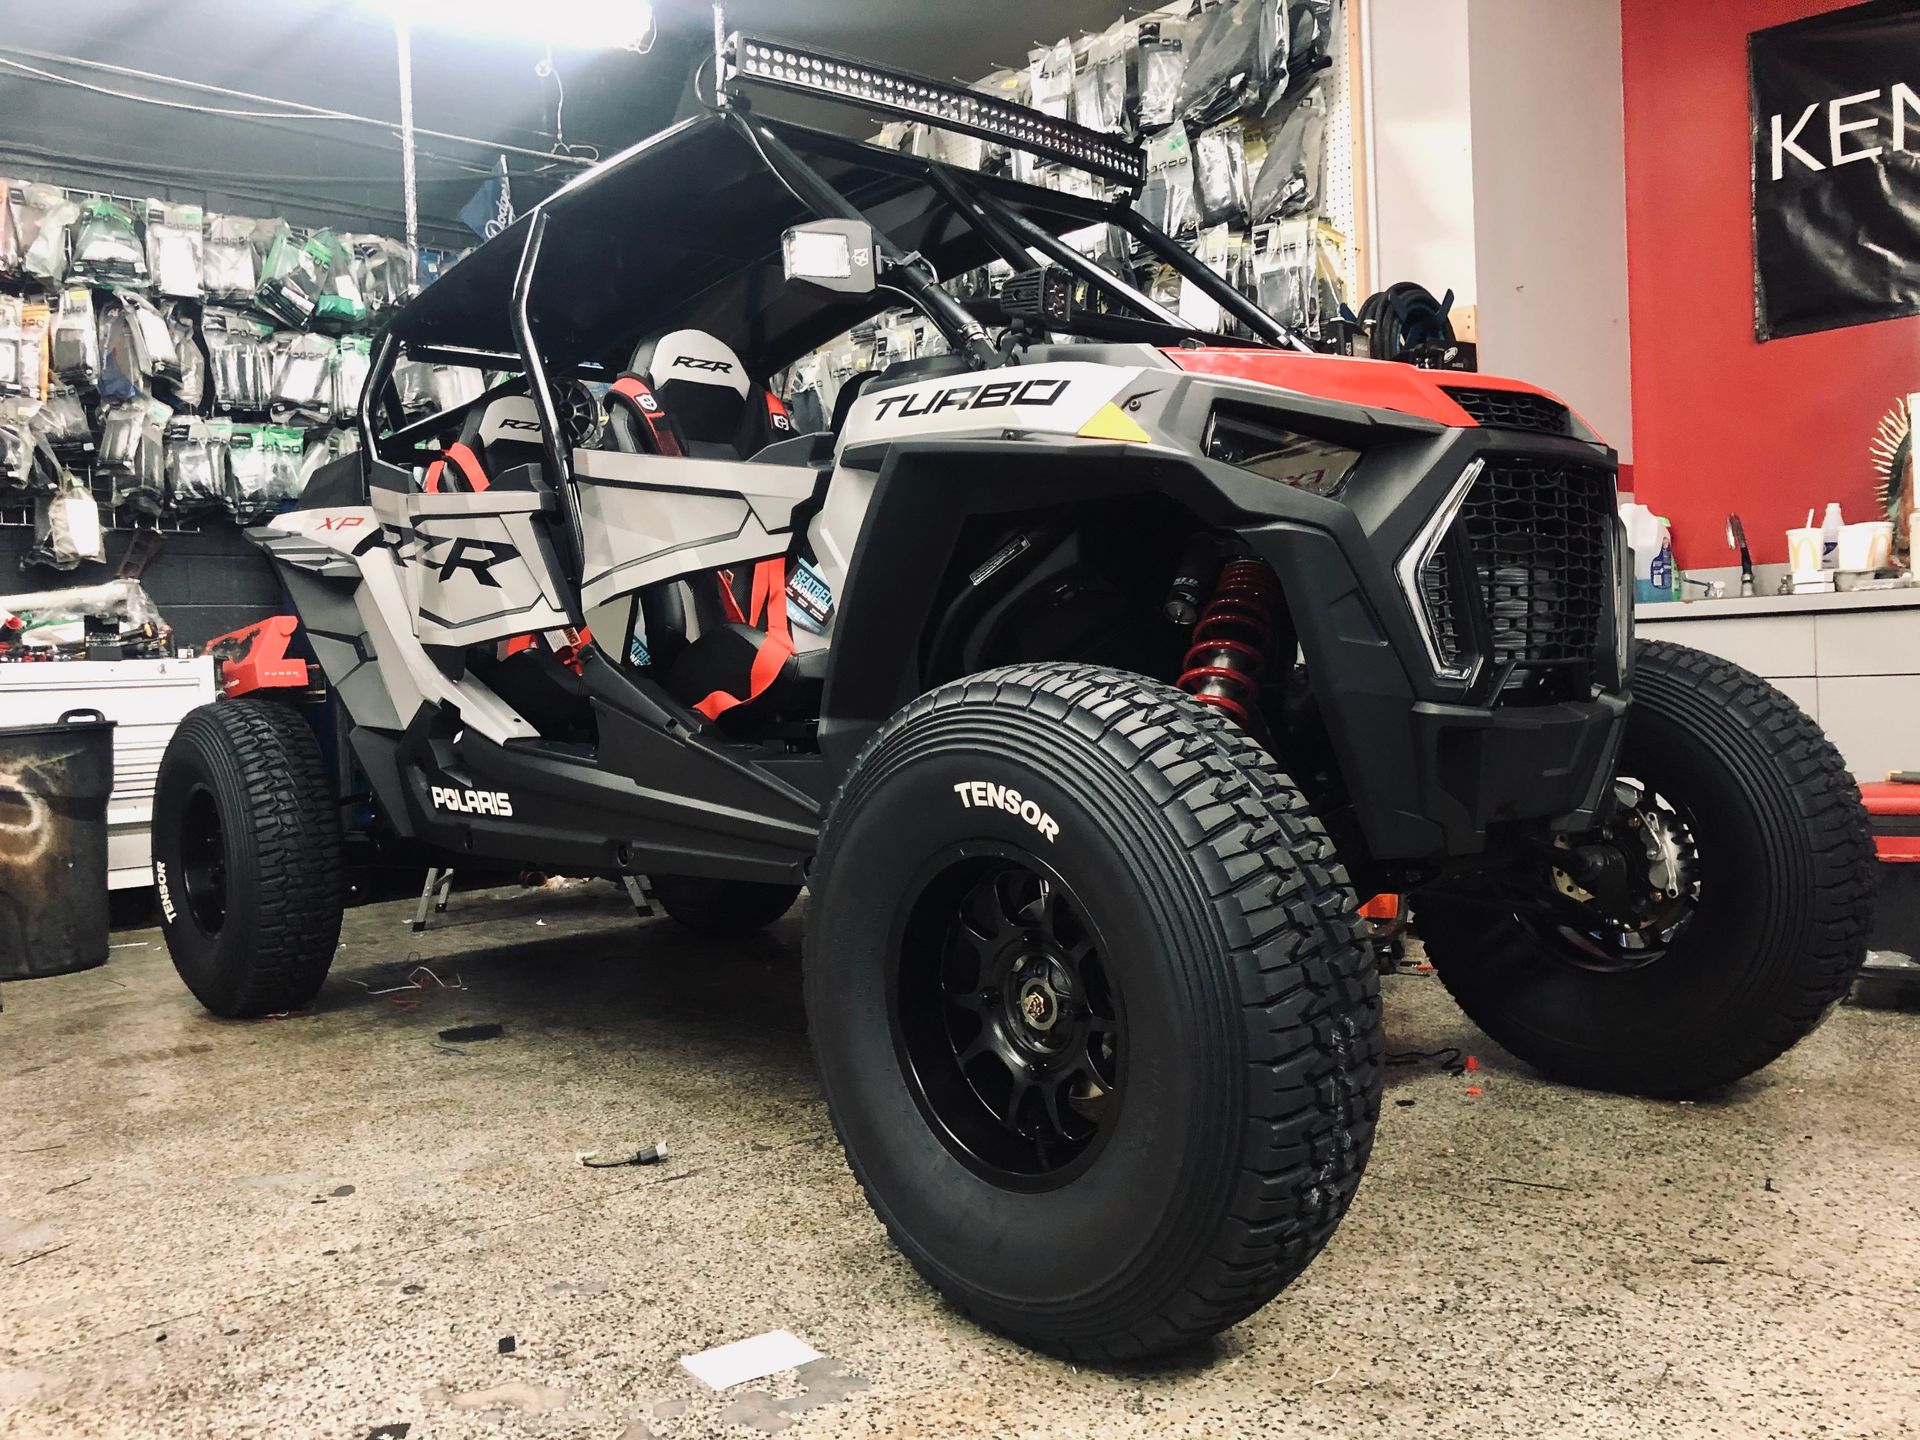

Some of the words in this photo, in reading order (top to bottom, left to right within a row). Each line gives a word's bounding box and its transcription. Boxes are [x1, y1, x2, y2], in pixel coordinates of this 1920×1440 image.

[672, 355, 733, 374] RZR
[874, 379, 1072, 422] TURBO
[315, 516, 365, 531] XP
[788, 577, 830, 615] HARNESS
[431, 786, 514, 817] POLARIS
[953, 781, 1060, 844] TENSOR
[156, 861, 178, 925] TENSOR
